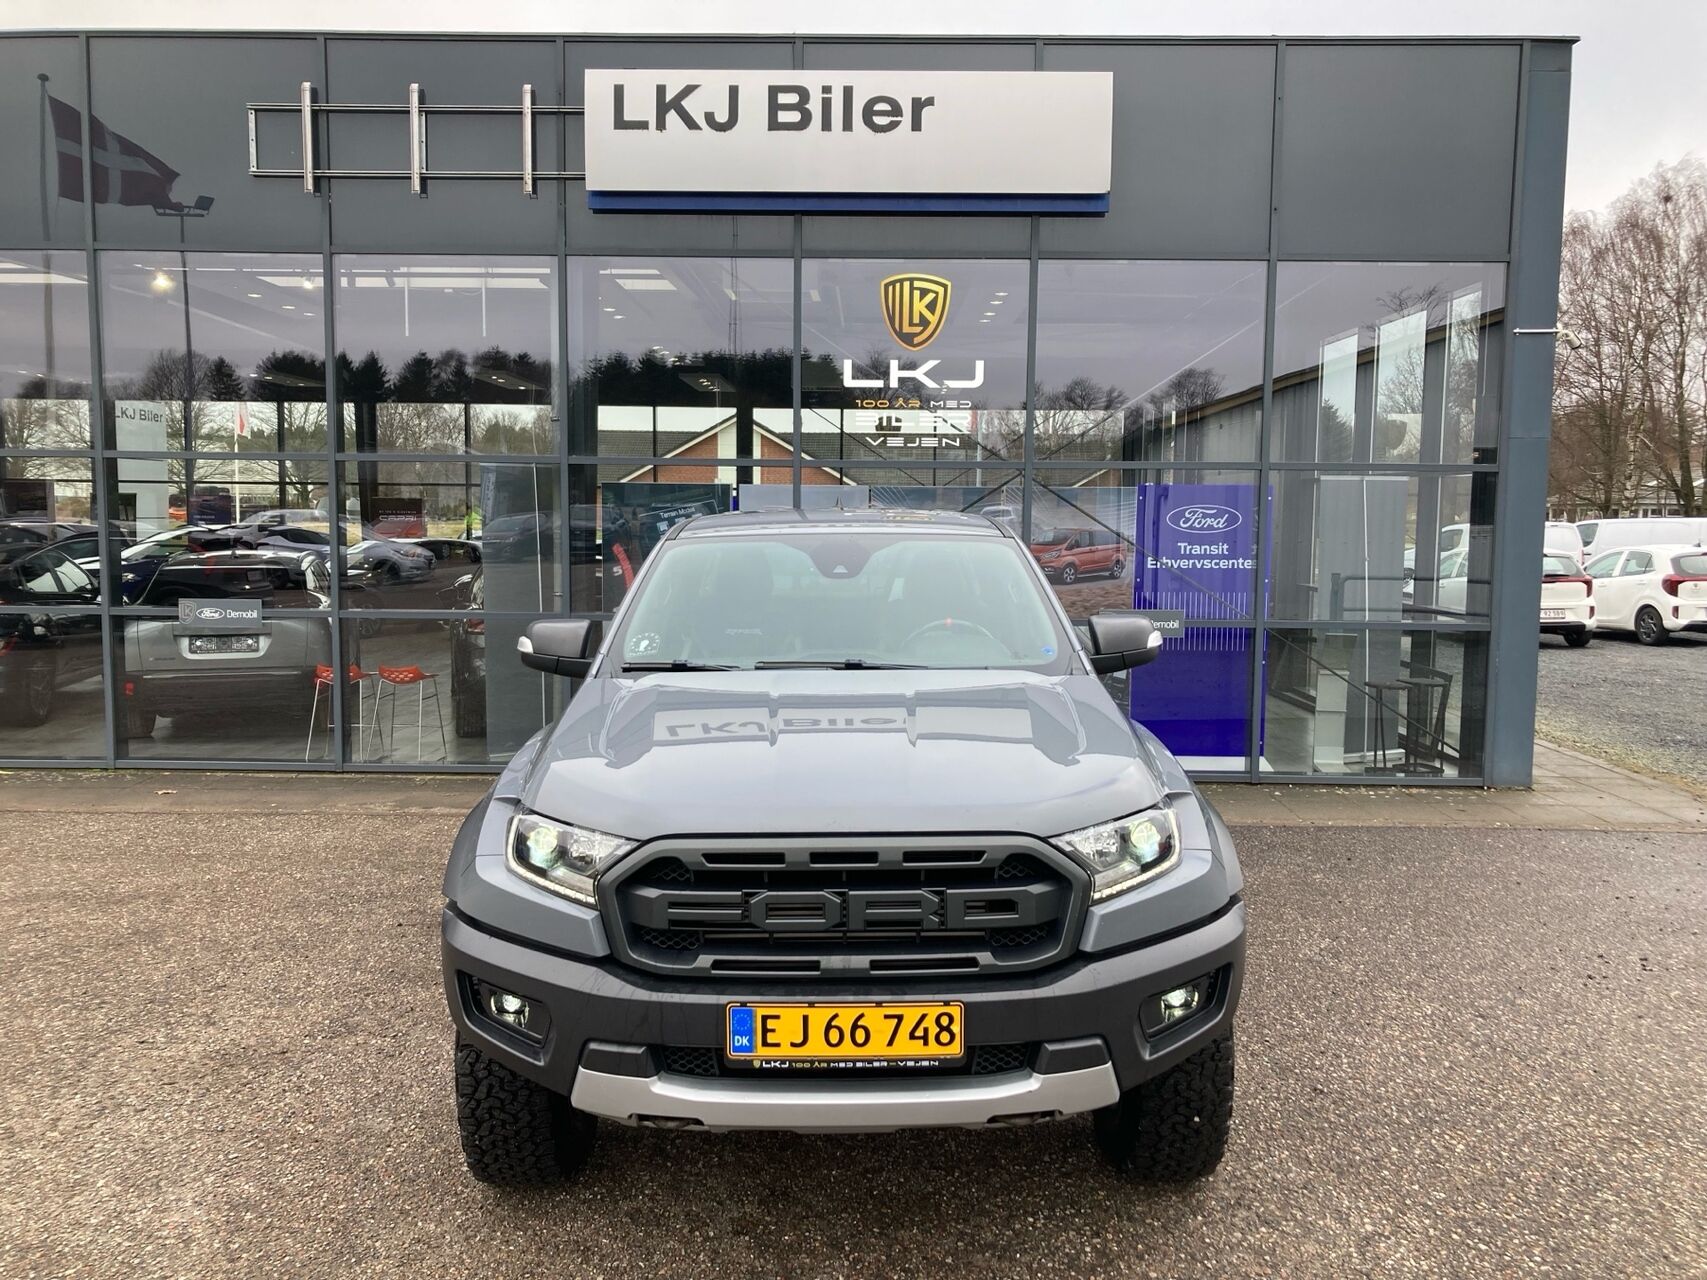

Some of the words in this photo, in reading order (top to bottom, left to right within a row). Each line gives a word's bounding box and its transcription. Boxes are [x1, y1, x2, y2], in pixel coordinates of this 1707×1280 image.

[613, 83, 740, 132] LKJ
[767, 84, 935, 133] Biler
[843, 359, 985, 388] LKJ
[856, 400, 889, 408] 100
[894, 397, 921, 408] ÅR
[930, 400, 972, 408] MED
[115, 407, 136, 420] KJ
[140, 409, 163, 422] Biler
[855, 412, 972, 427] BILER
[865, 436, 960, 447] VEJEN
[1179, 507, 1229, 528] Ford
[1178, 542, 1229, 555] Transit
[1147, 556, 1254, 569] Erhvervscente
[226, 609, 258, 619] Demobil
[1151, 619, 1180, 629] emobil
[636, 888, 1052, 931] FORD
[734, 1036, 750, 1047] DK
[760, 1014, 810, 1048] EJ
[823, 1013, 872, 1048] 66
[883, 1011, 957, 1047] 748
[762, 1060, 789, 1068] LKJ
